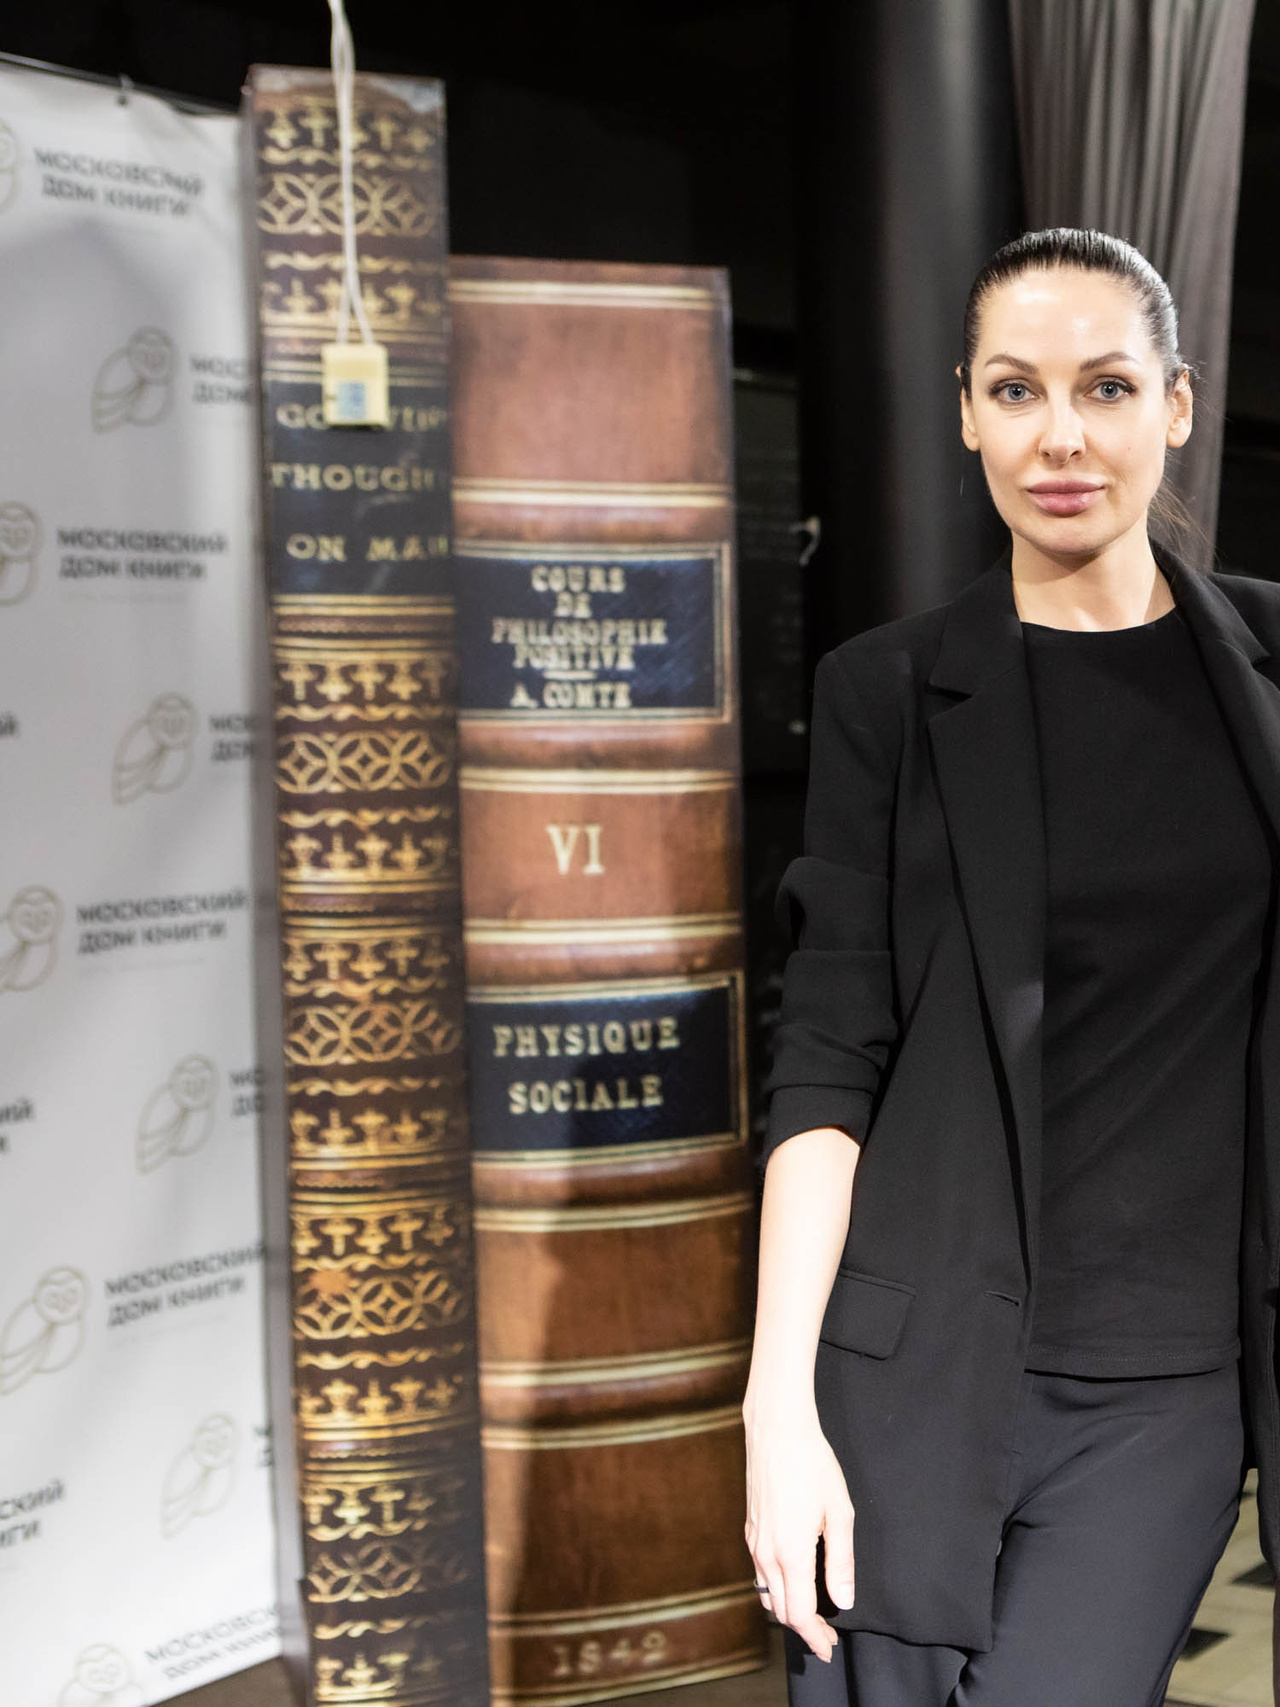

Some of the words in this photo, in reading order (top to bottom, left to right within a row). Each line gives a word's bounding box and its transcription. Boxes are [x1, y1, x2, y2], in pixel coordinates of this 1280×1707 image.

[531, 565, 626, 593] COURS
[491, 618, 668, 646] PHILOSOPHIE
[546, 823, 604, 875] VI
[492, 1016, 680, 1057] PHYSIQUE
[508, 1074, 663, 1115] SOCIALE
